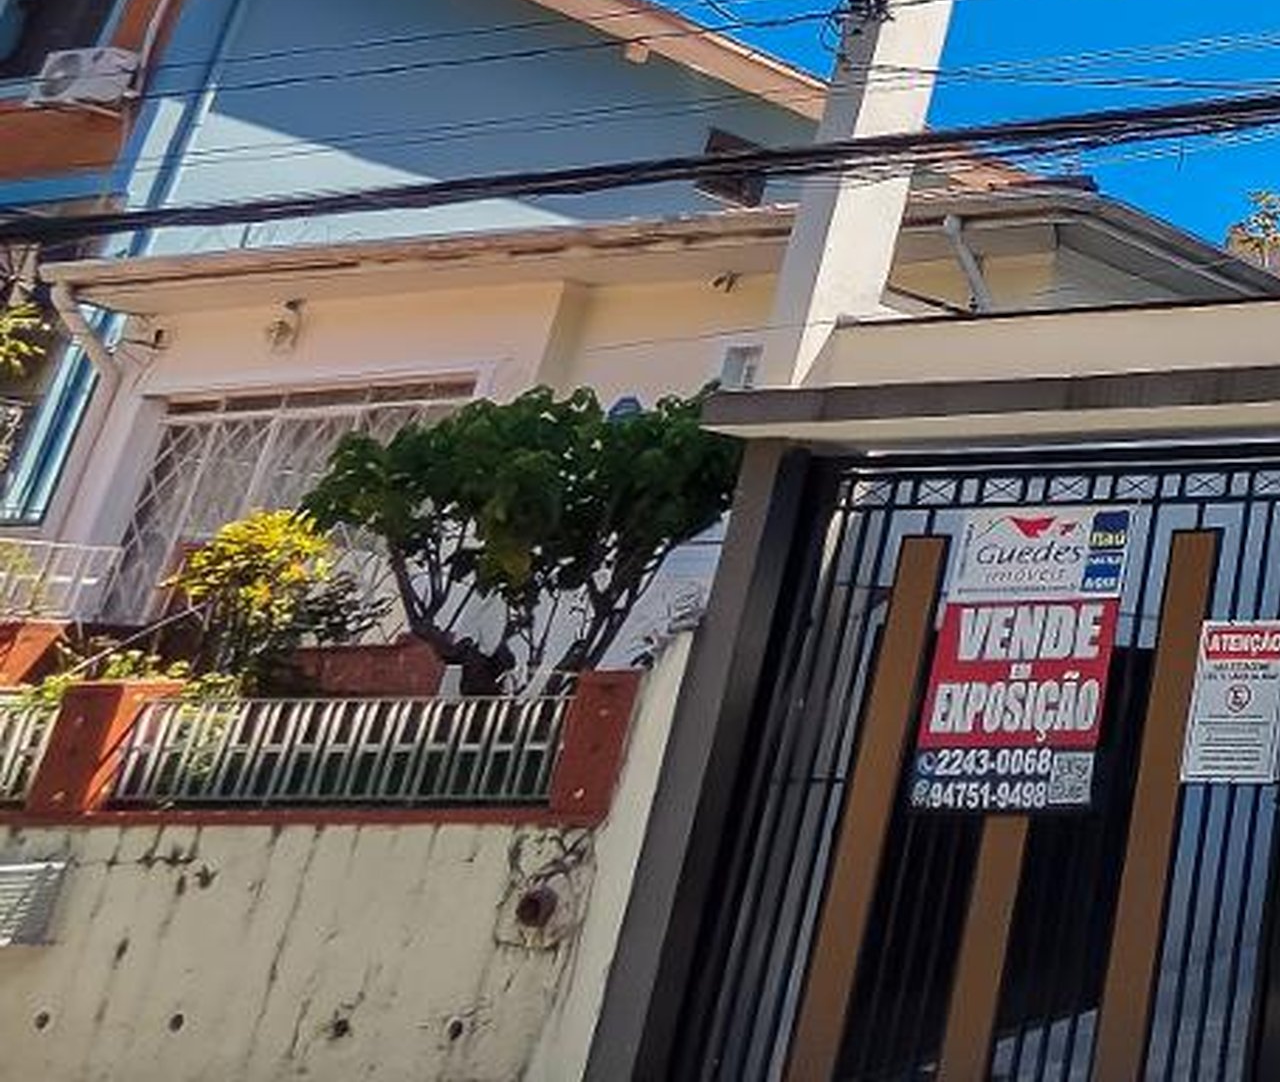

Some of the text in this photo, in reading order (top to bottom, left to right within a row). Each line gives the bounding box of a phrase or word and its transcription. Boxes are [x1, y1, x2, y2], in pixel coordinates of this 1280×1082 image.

[976, 540, 1084, 565] Guedes
[957, 603, 1106, 662] VENDE
[929, 671, 1100, 742] EXPOSIÇÃO
[934, 748, 1052, 776] 2243-0068
[930, 781, 1047, 809] 94751-9498
